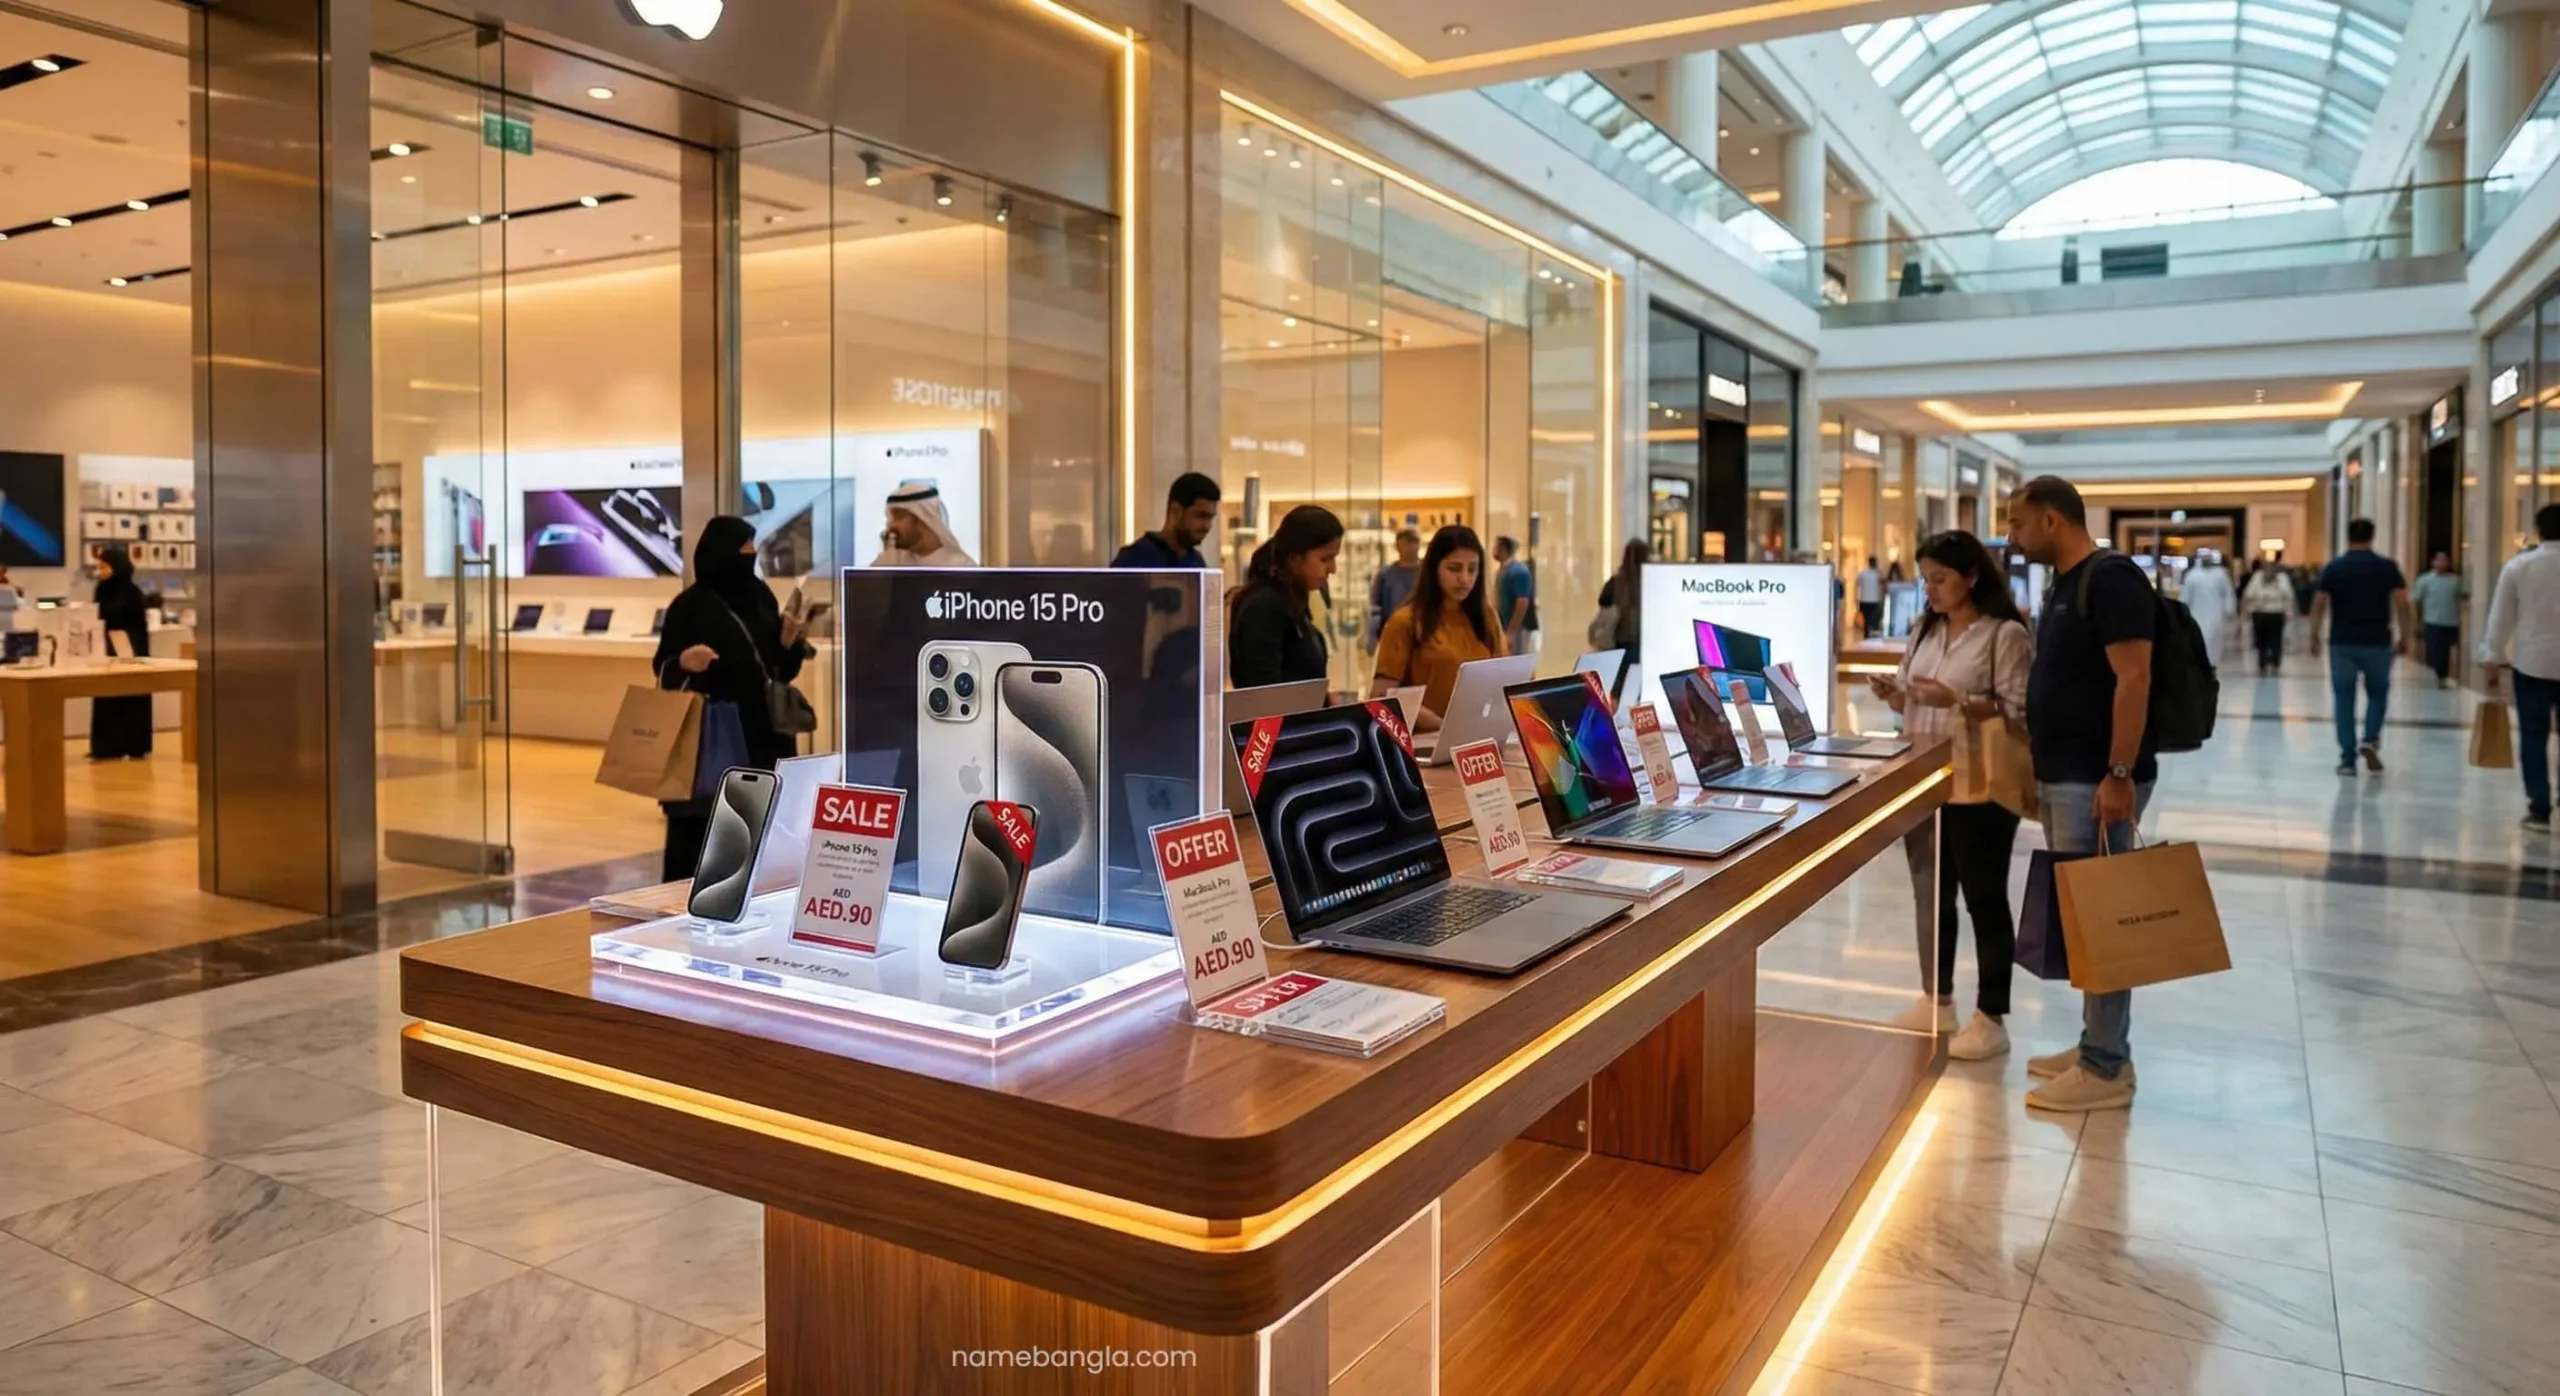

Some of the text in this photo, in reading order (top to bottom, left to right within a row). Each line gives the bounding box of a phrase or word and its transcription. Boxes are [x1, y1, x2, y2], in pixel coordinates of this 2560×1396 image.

[1682, 578, 1786, 594] MacBook Pro
[945, 591, 1105, 623] iPhone 15 Pro
[1378, 709, 1409, 748] SALE
[1247, 729, 1271, 774] SALE
[1461, 752, 1499, 778] OFFER
[822, 796, 892, 829] SALE
[997, 807, 1031, 849] SALE
[852, 843, 863, 855] 15
[1165, 828, 1229, 868] OFFER
[832, 887, 851, 899] AED
[804, 897, 873, 926] AED.90
[1211, 930, 1227, 944] AED
[1194, 937, 1255, 980] AED.90
